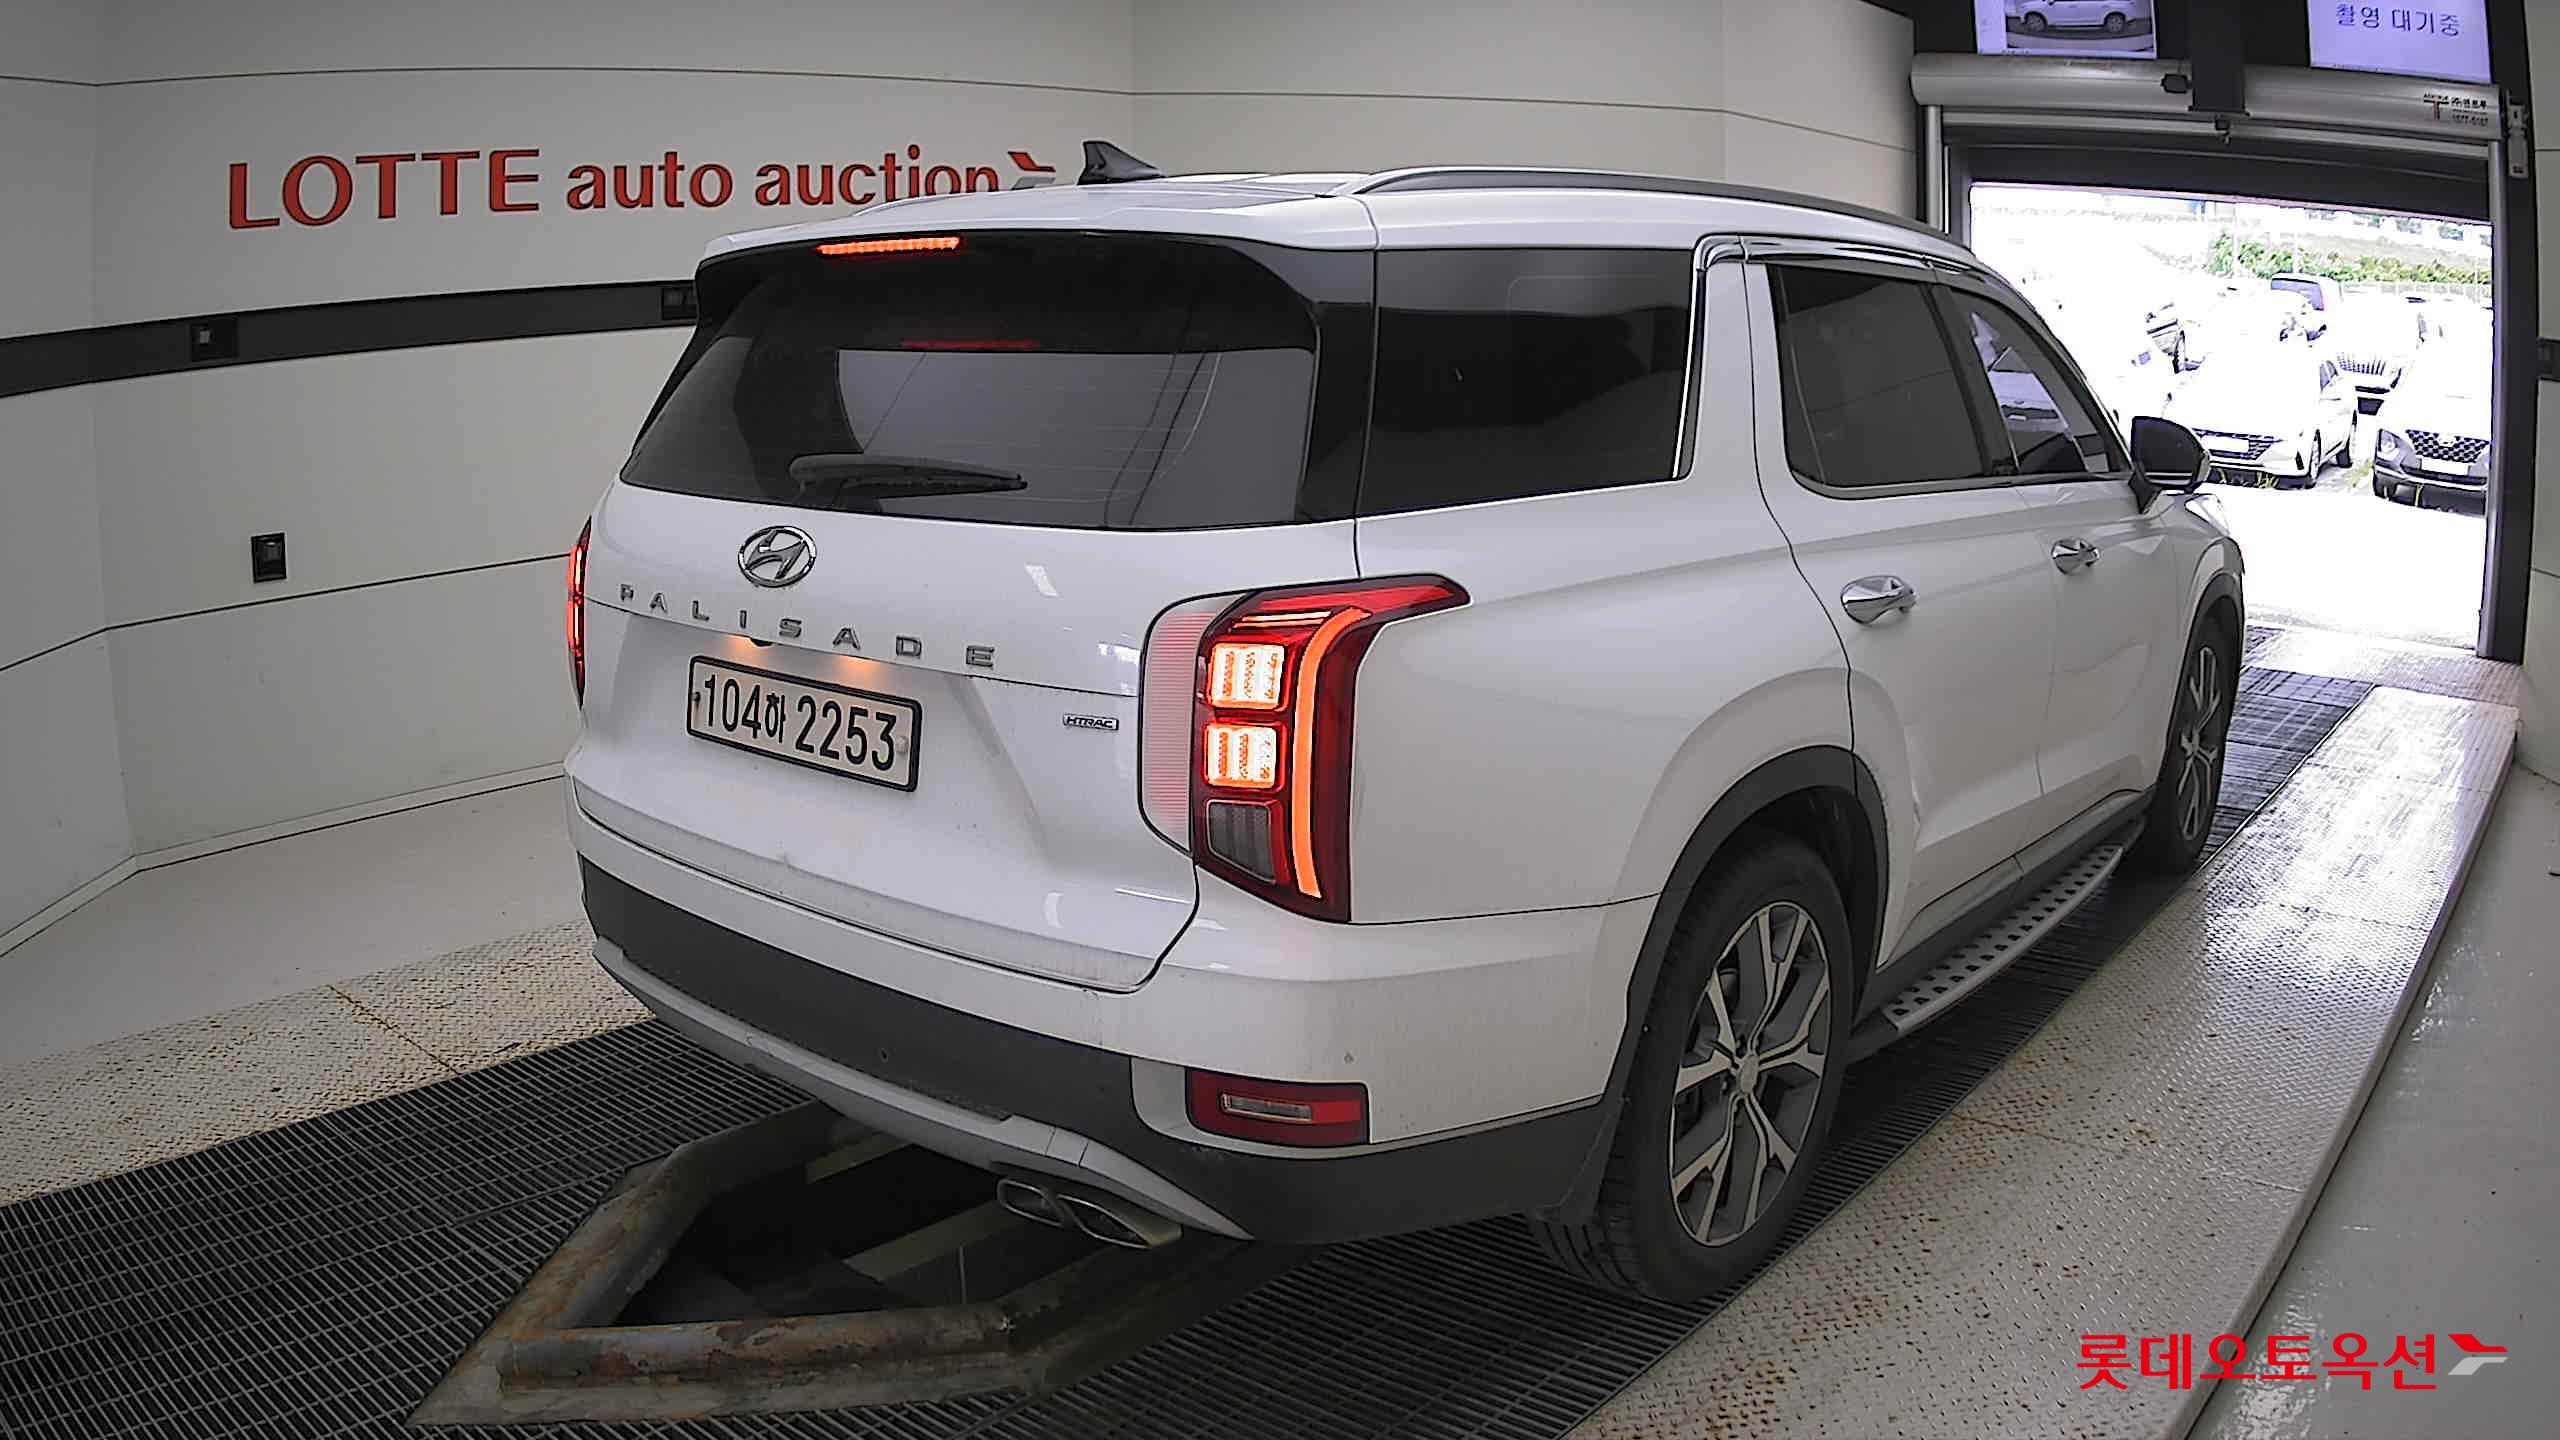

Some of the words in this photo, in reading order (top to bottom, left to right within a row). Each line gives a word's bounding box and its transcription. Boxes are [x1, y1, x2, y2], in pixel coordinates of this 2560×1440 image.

[2391, 8, 2459, 37] 대기중
[228, 148, 541, 229] LOTTE
[566, 151, 733, 210] auto
[754, 144, 1000, 207] auction
[620, 583, 997, 669] PALISADE
[704, 673, 786, 744] 104하
[795, 694, 897, 771] 2253
[1065, 716, 1114, 729] HTRAC
